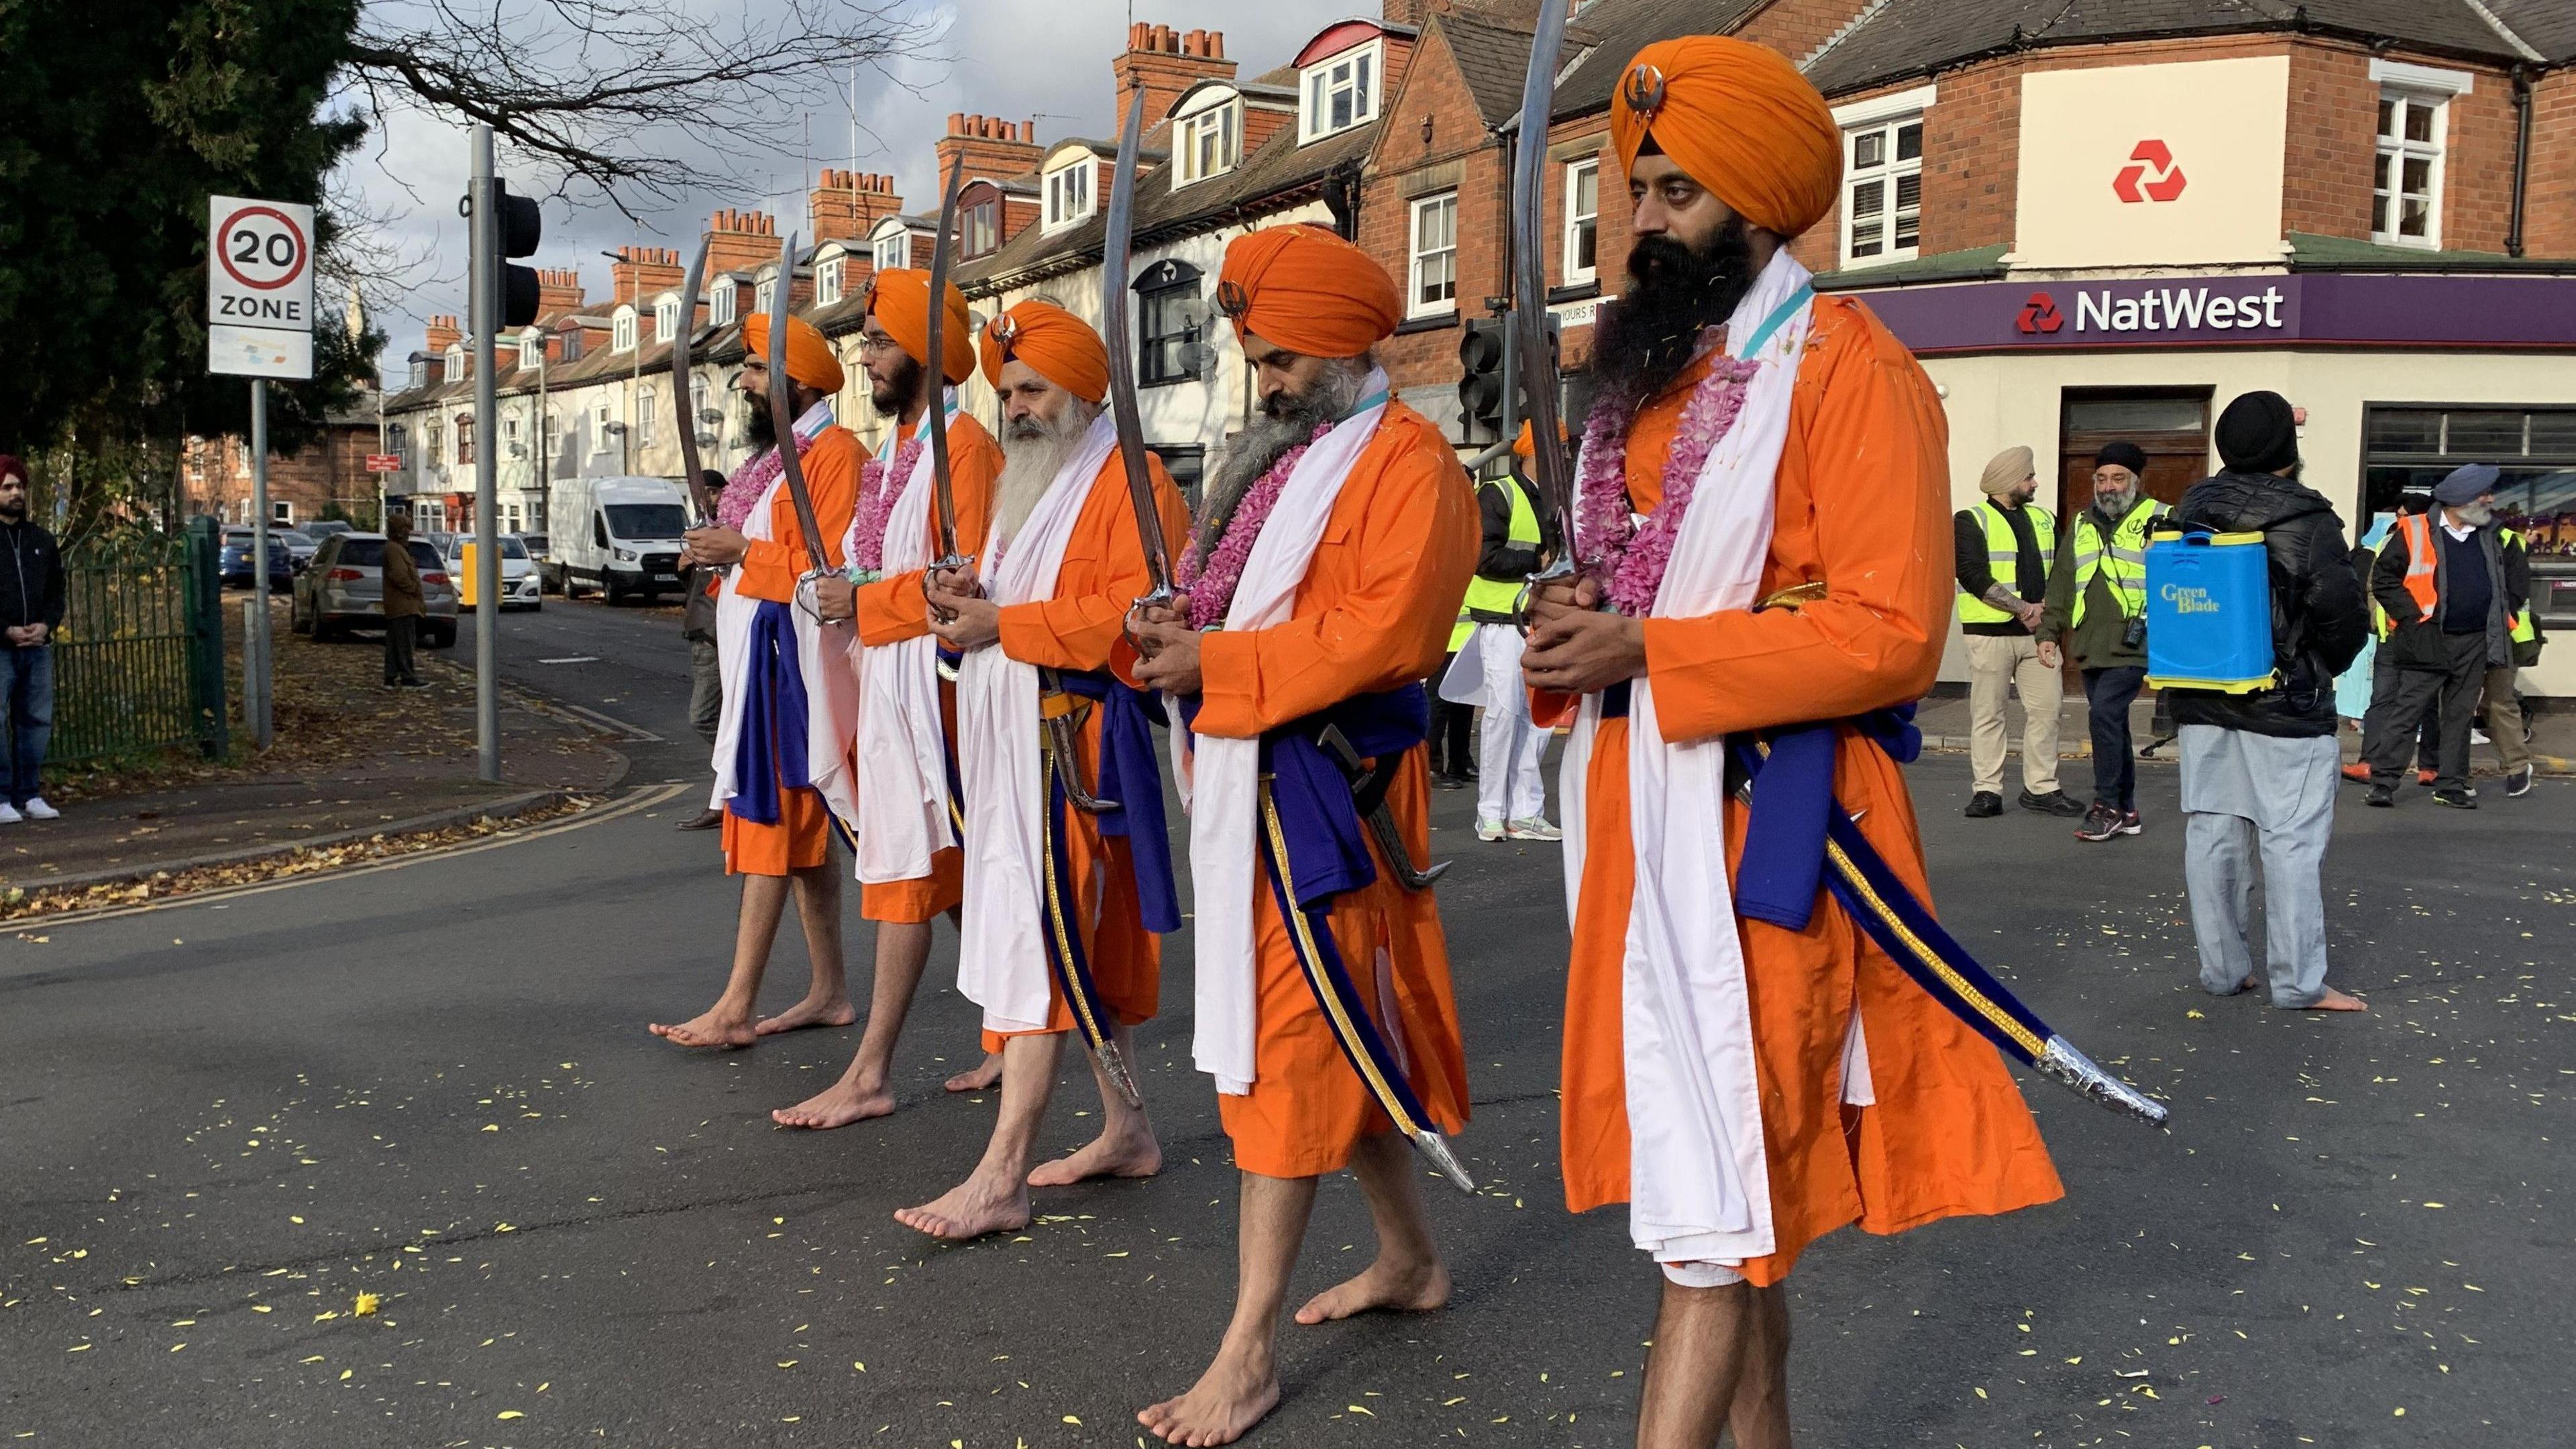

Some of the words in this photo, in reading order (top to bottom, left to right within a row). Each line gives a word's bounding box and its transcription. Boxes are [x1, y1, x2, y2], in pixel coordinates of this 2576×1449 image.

[233, 230, 295, 266] 20
[220, 295, 301, 320] ZONE
[1590, 305, 1595, 317] R
[2076, 286, 2284, 331] NatWest
[2161, 584, 2206, 600] Green
[2178, 598, 2219, 613] Blade
